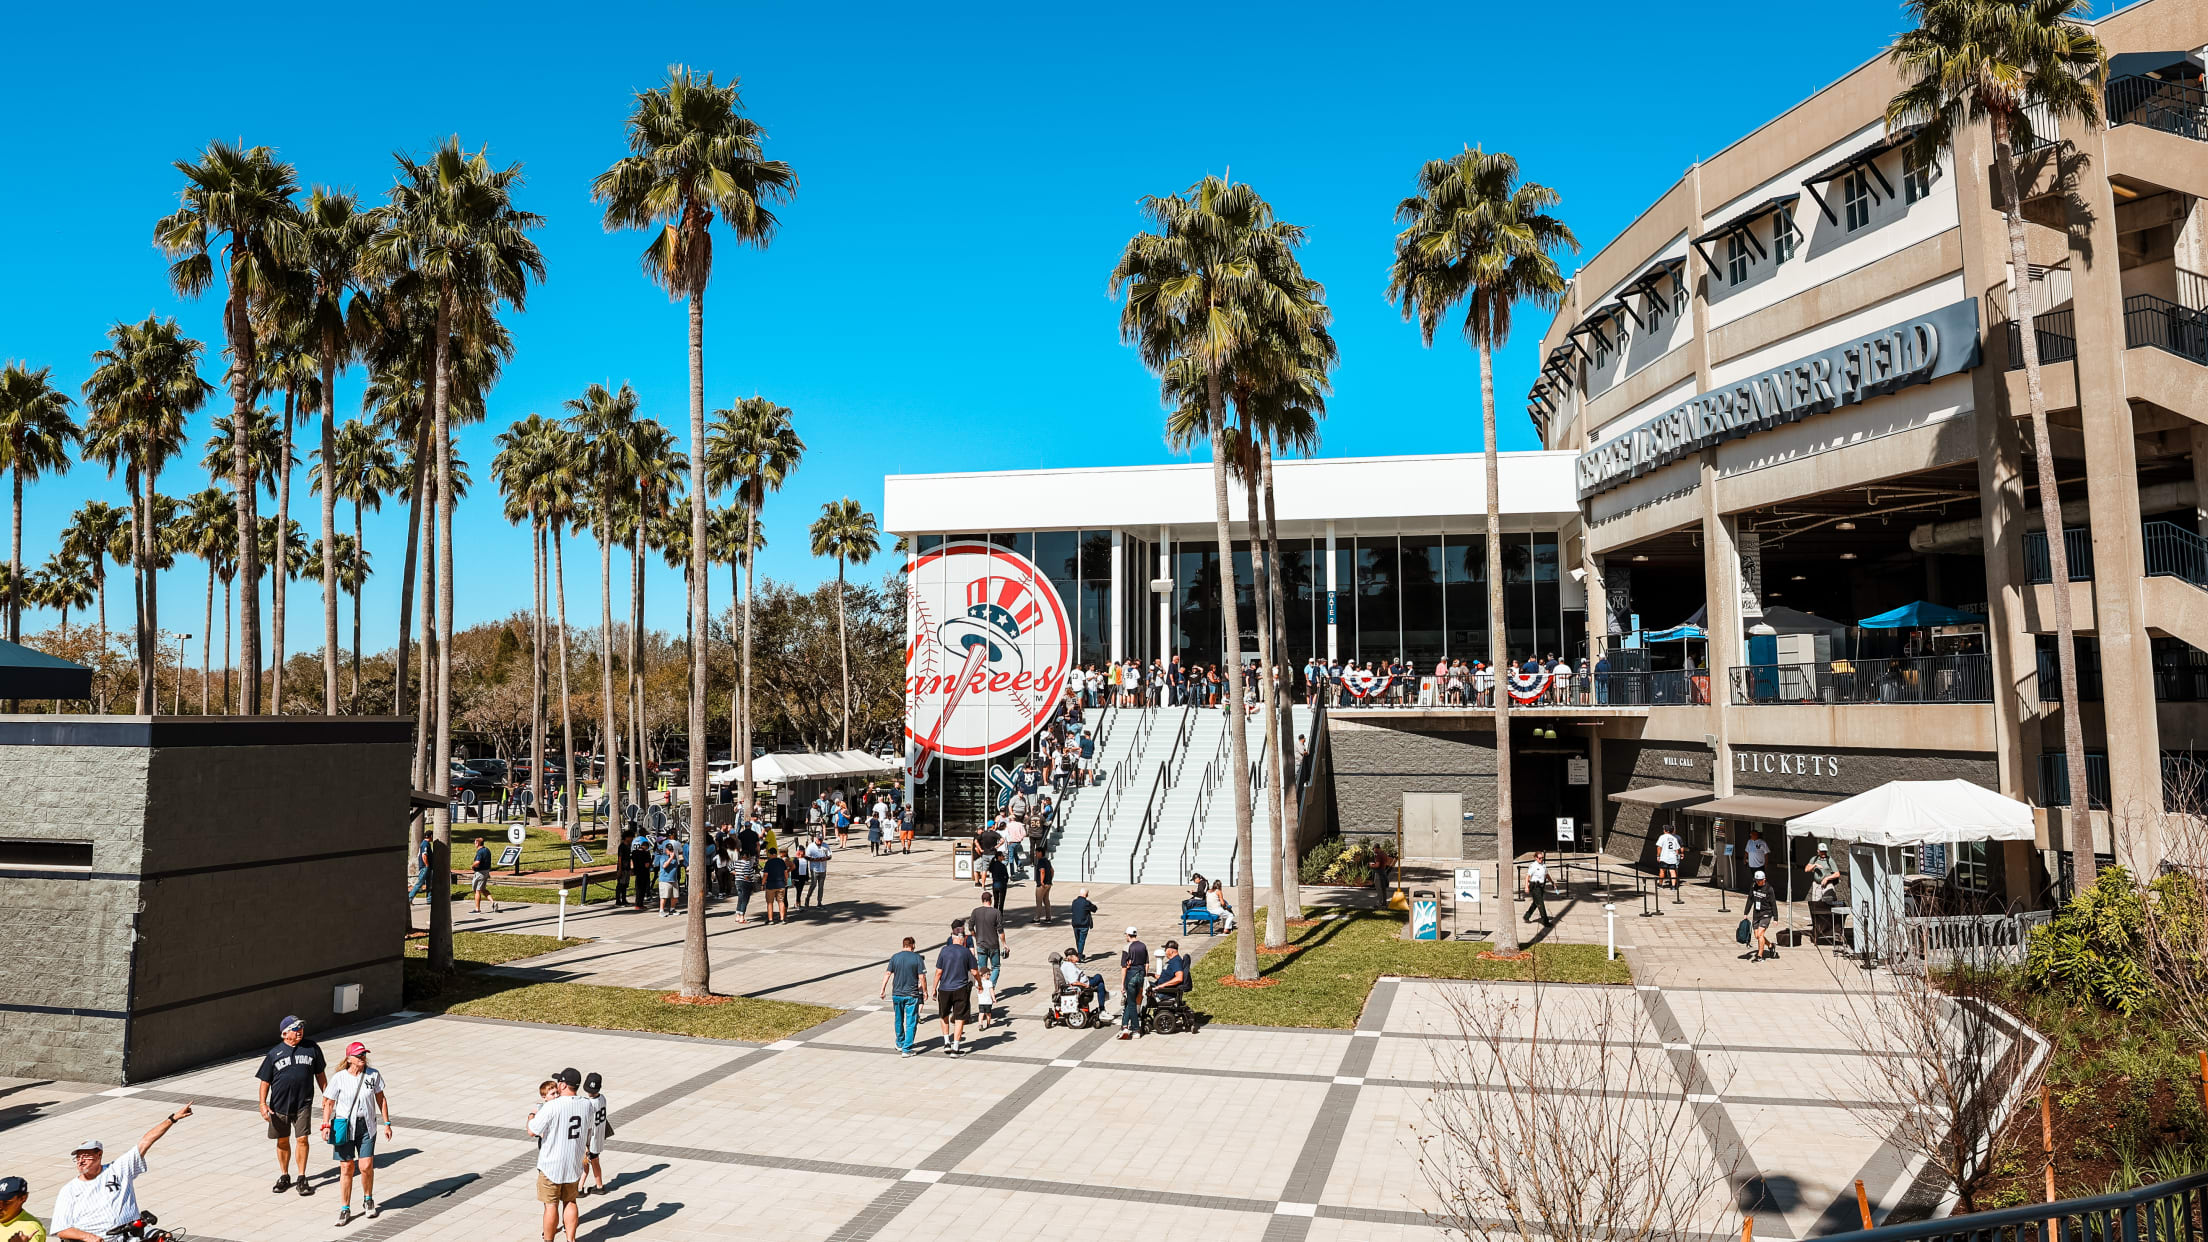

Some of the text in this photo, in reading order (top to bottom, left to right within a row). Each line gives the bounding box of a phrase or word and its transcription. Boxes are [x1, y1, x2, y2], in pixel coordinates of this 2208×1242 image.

[1838, 322, 1939, 393] FIELD
[1663, 756, 1694, 767] WILL CALL
[1737, 753, 1839, 777] TICKETS
[513, 828, 520, 840] 9
[571, 826, 579, 838] 10
[1667, 841, 1674, 850] 2
[274, 1056, 292, 1071] NEW
[594, 1106, 607, 1127] 99
[567, 1115, 582, 1140] 2
